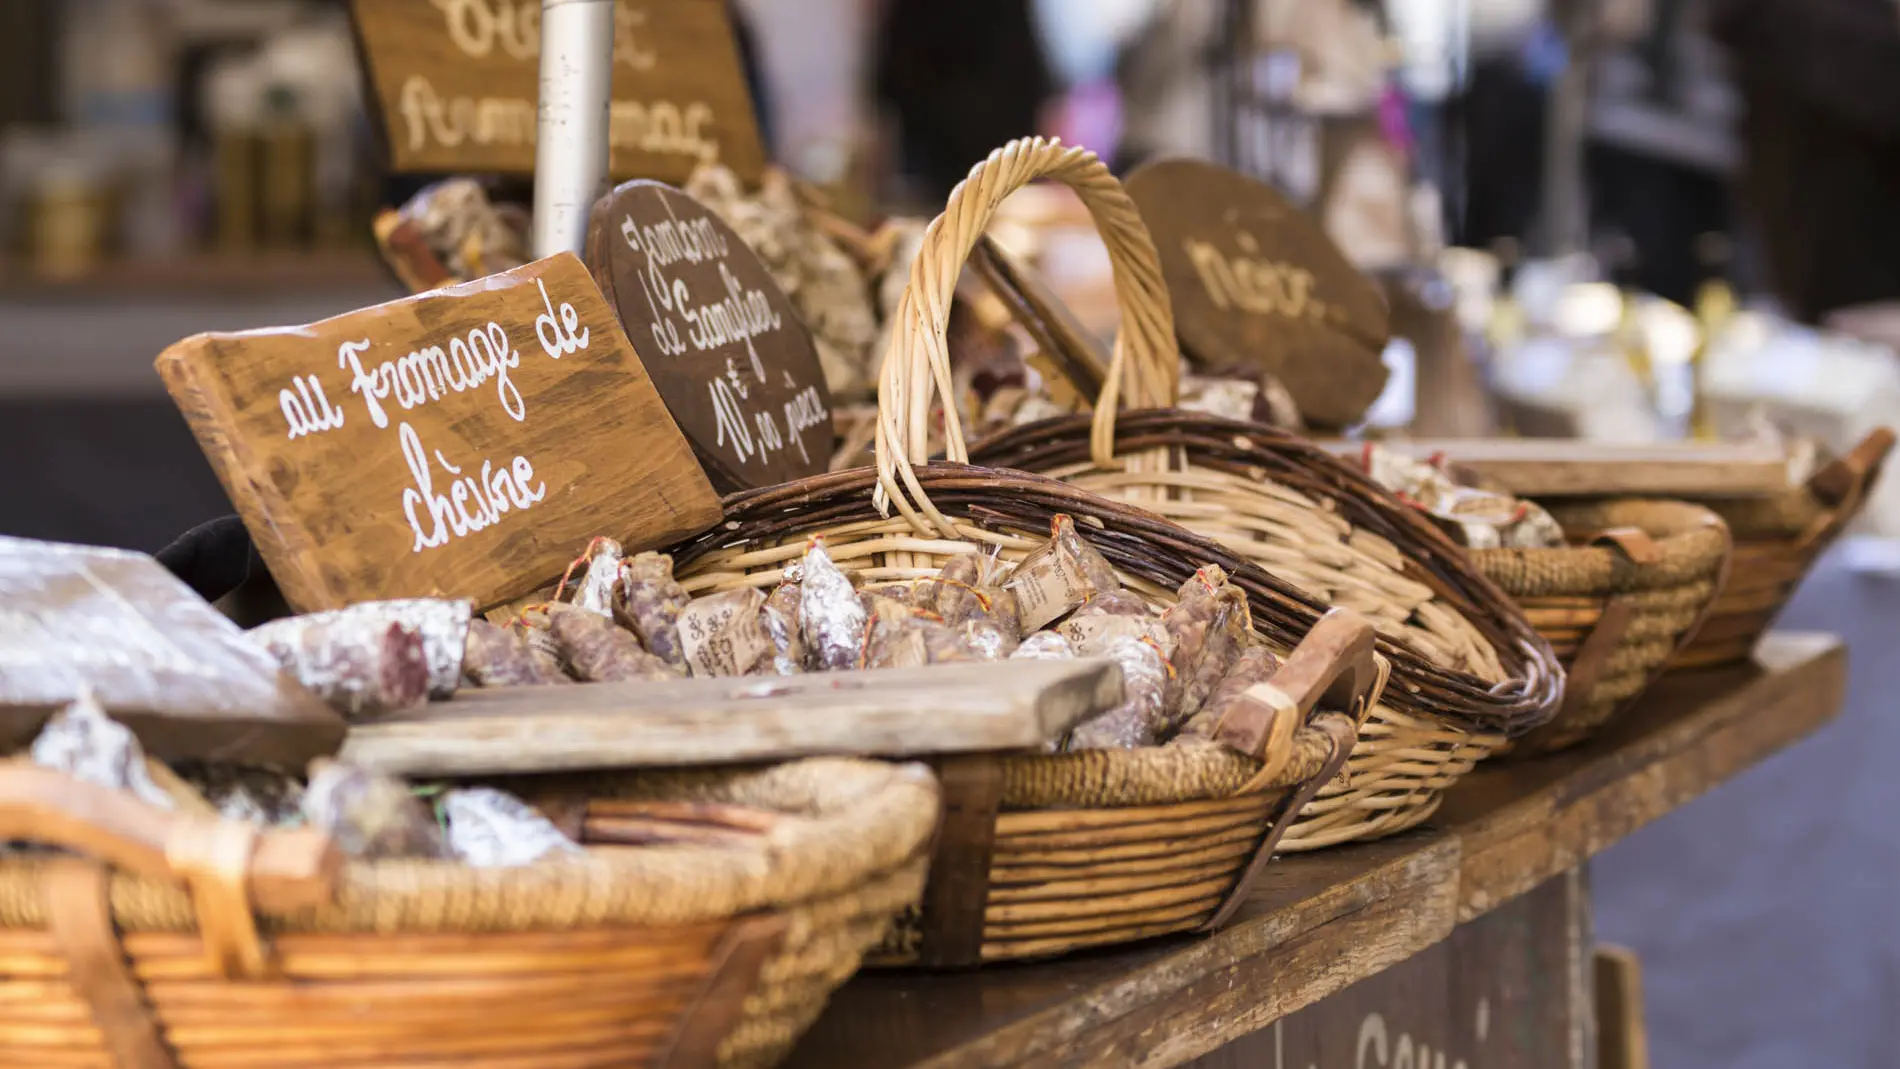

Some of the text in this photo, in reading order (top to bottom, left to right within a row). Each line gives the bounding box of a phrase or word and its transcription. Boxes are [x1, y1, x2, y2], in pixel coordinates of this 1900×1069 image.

[620, 187, 729, 311] Jambon
[278, 277, 590, 440] au Fromage de
[637, 262, 781, 384] de Sanglier
[398, 420, 546, 553] chèvre
